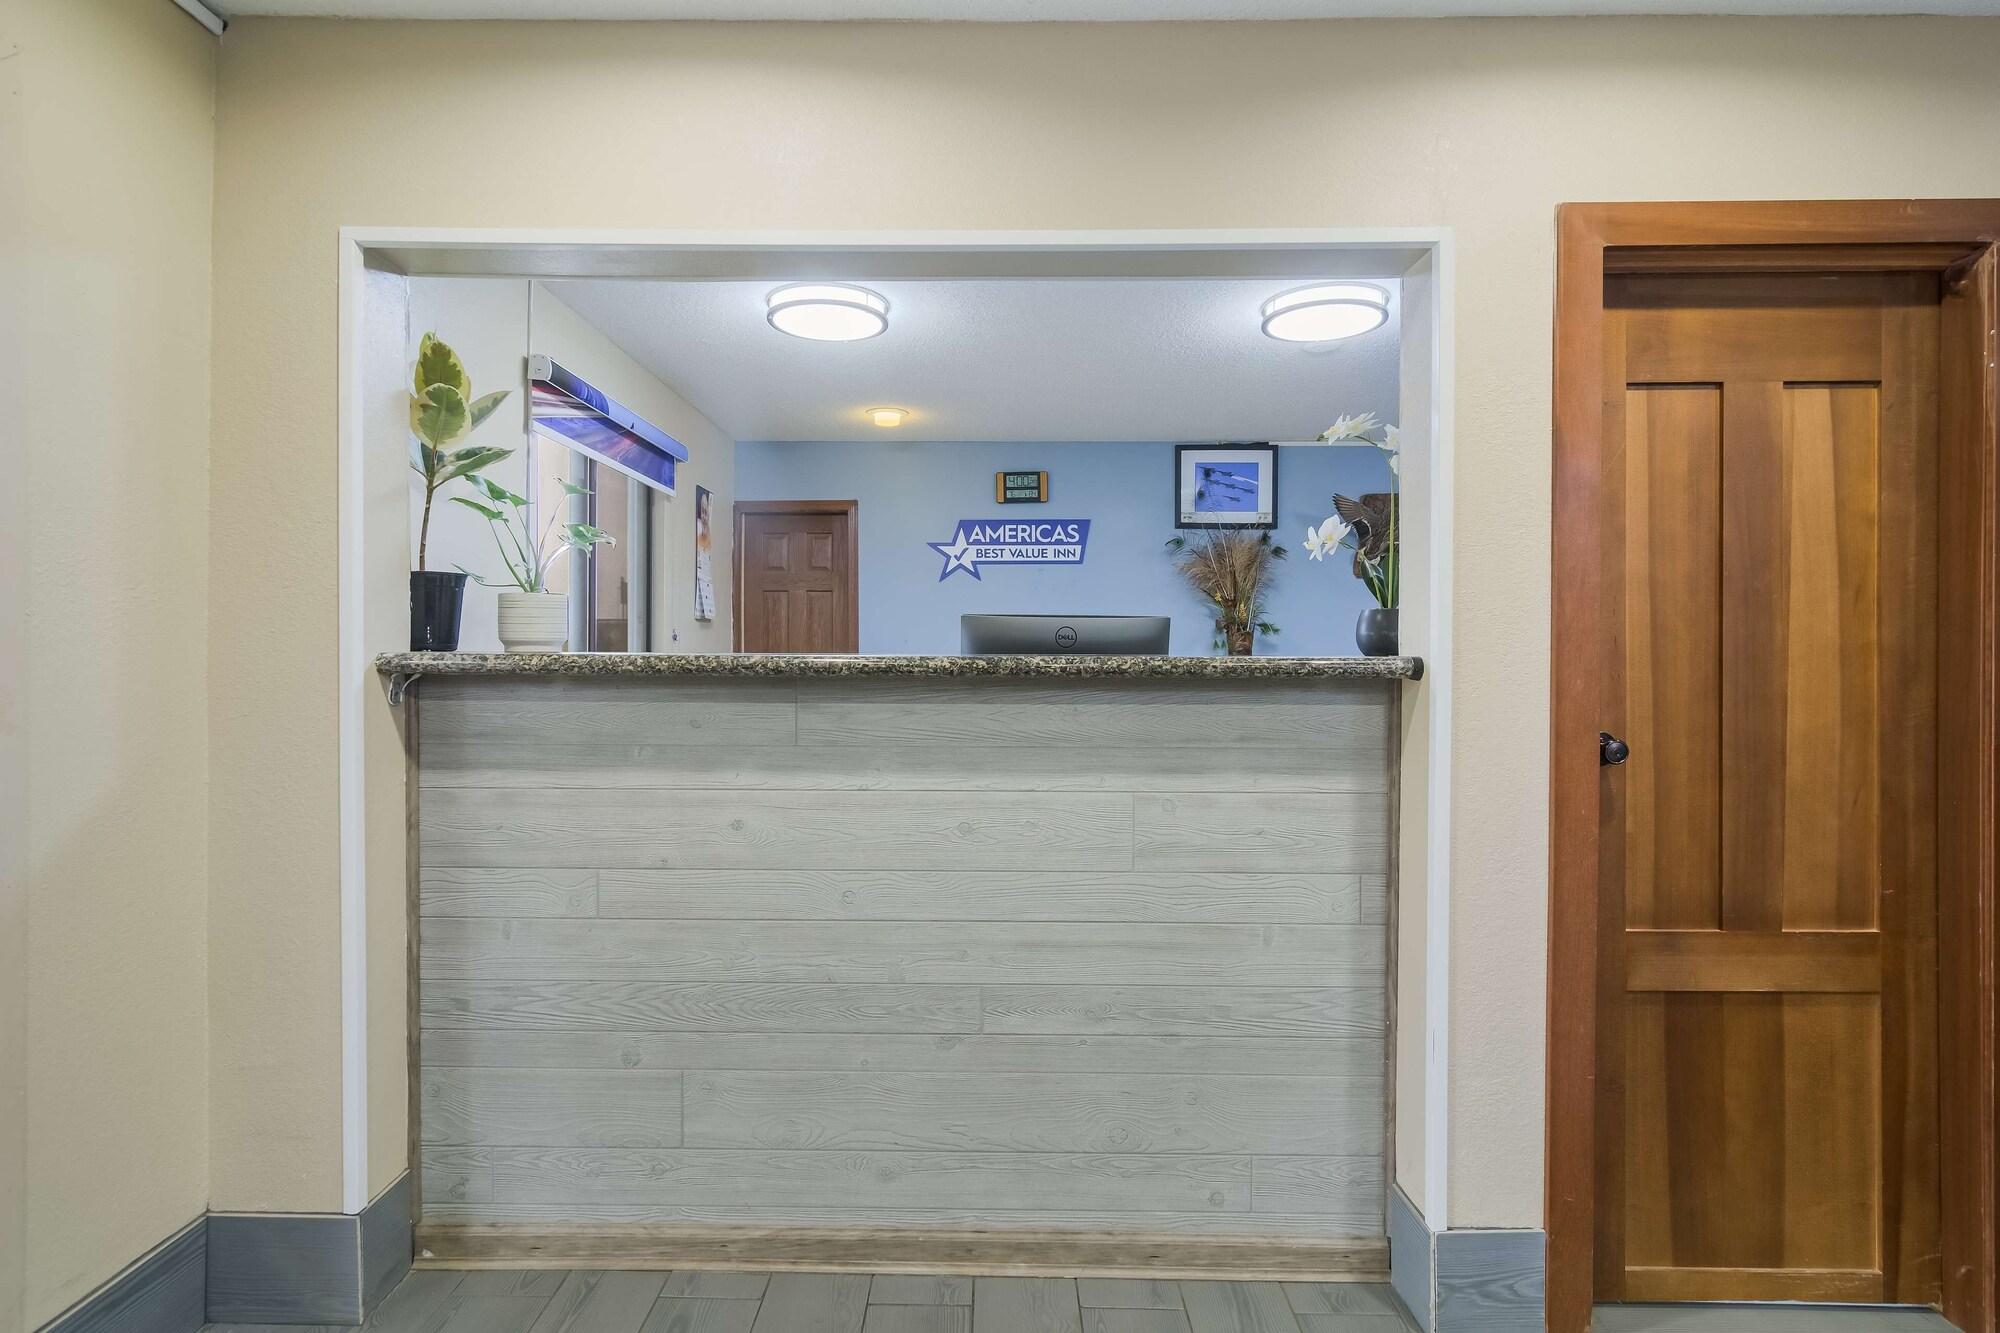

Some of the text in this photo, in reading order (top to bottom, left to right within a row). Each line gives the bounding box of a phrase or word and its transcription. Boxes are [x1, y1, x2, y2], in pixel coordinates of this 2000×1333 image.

[968, 524, 1080, 543] AMERICAS
[976, 548, 1076, 559] BEST VALUE INN
